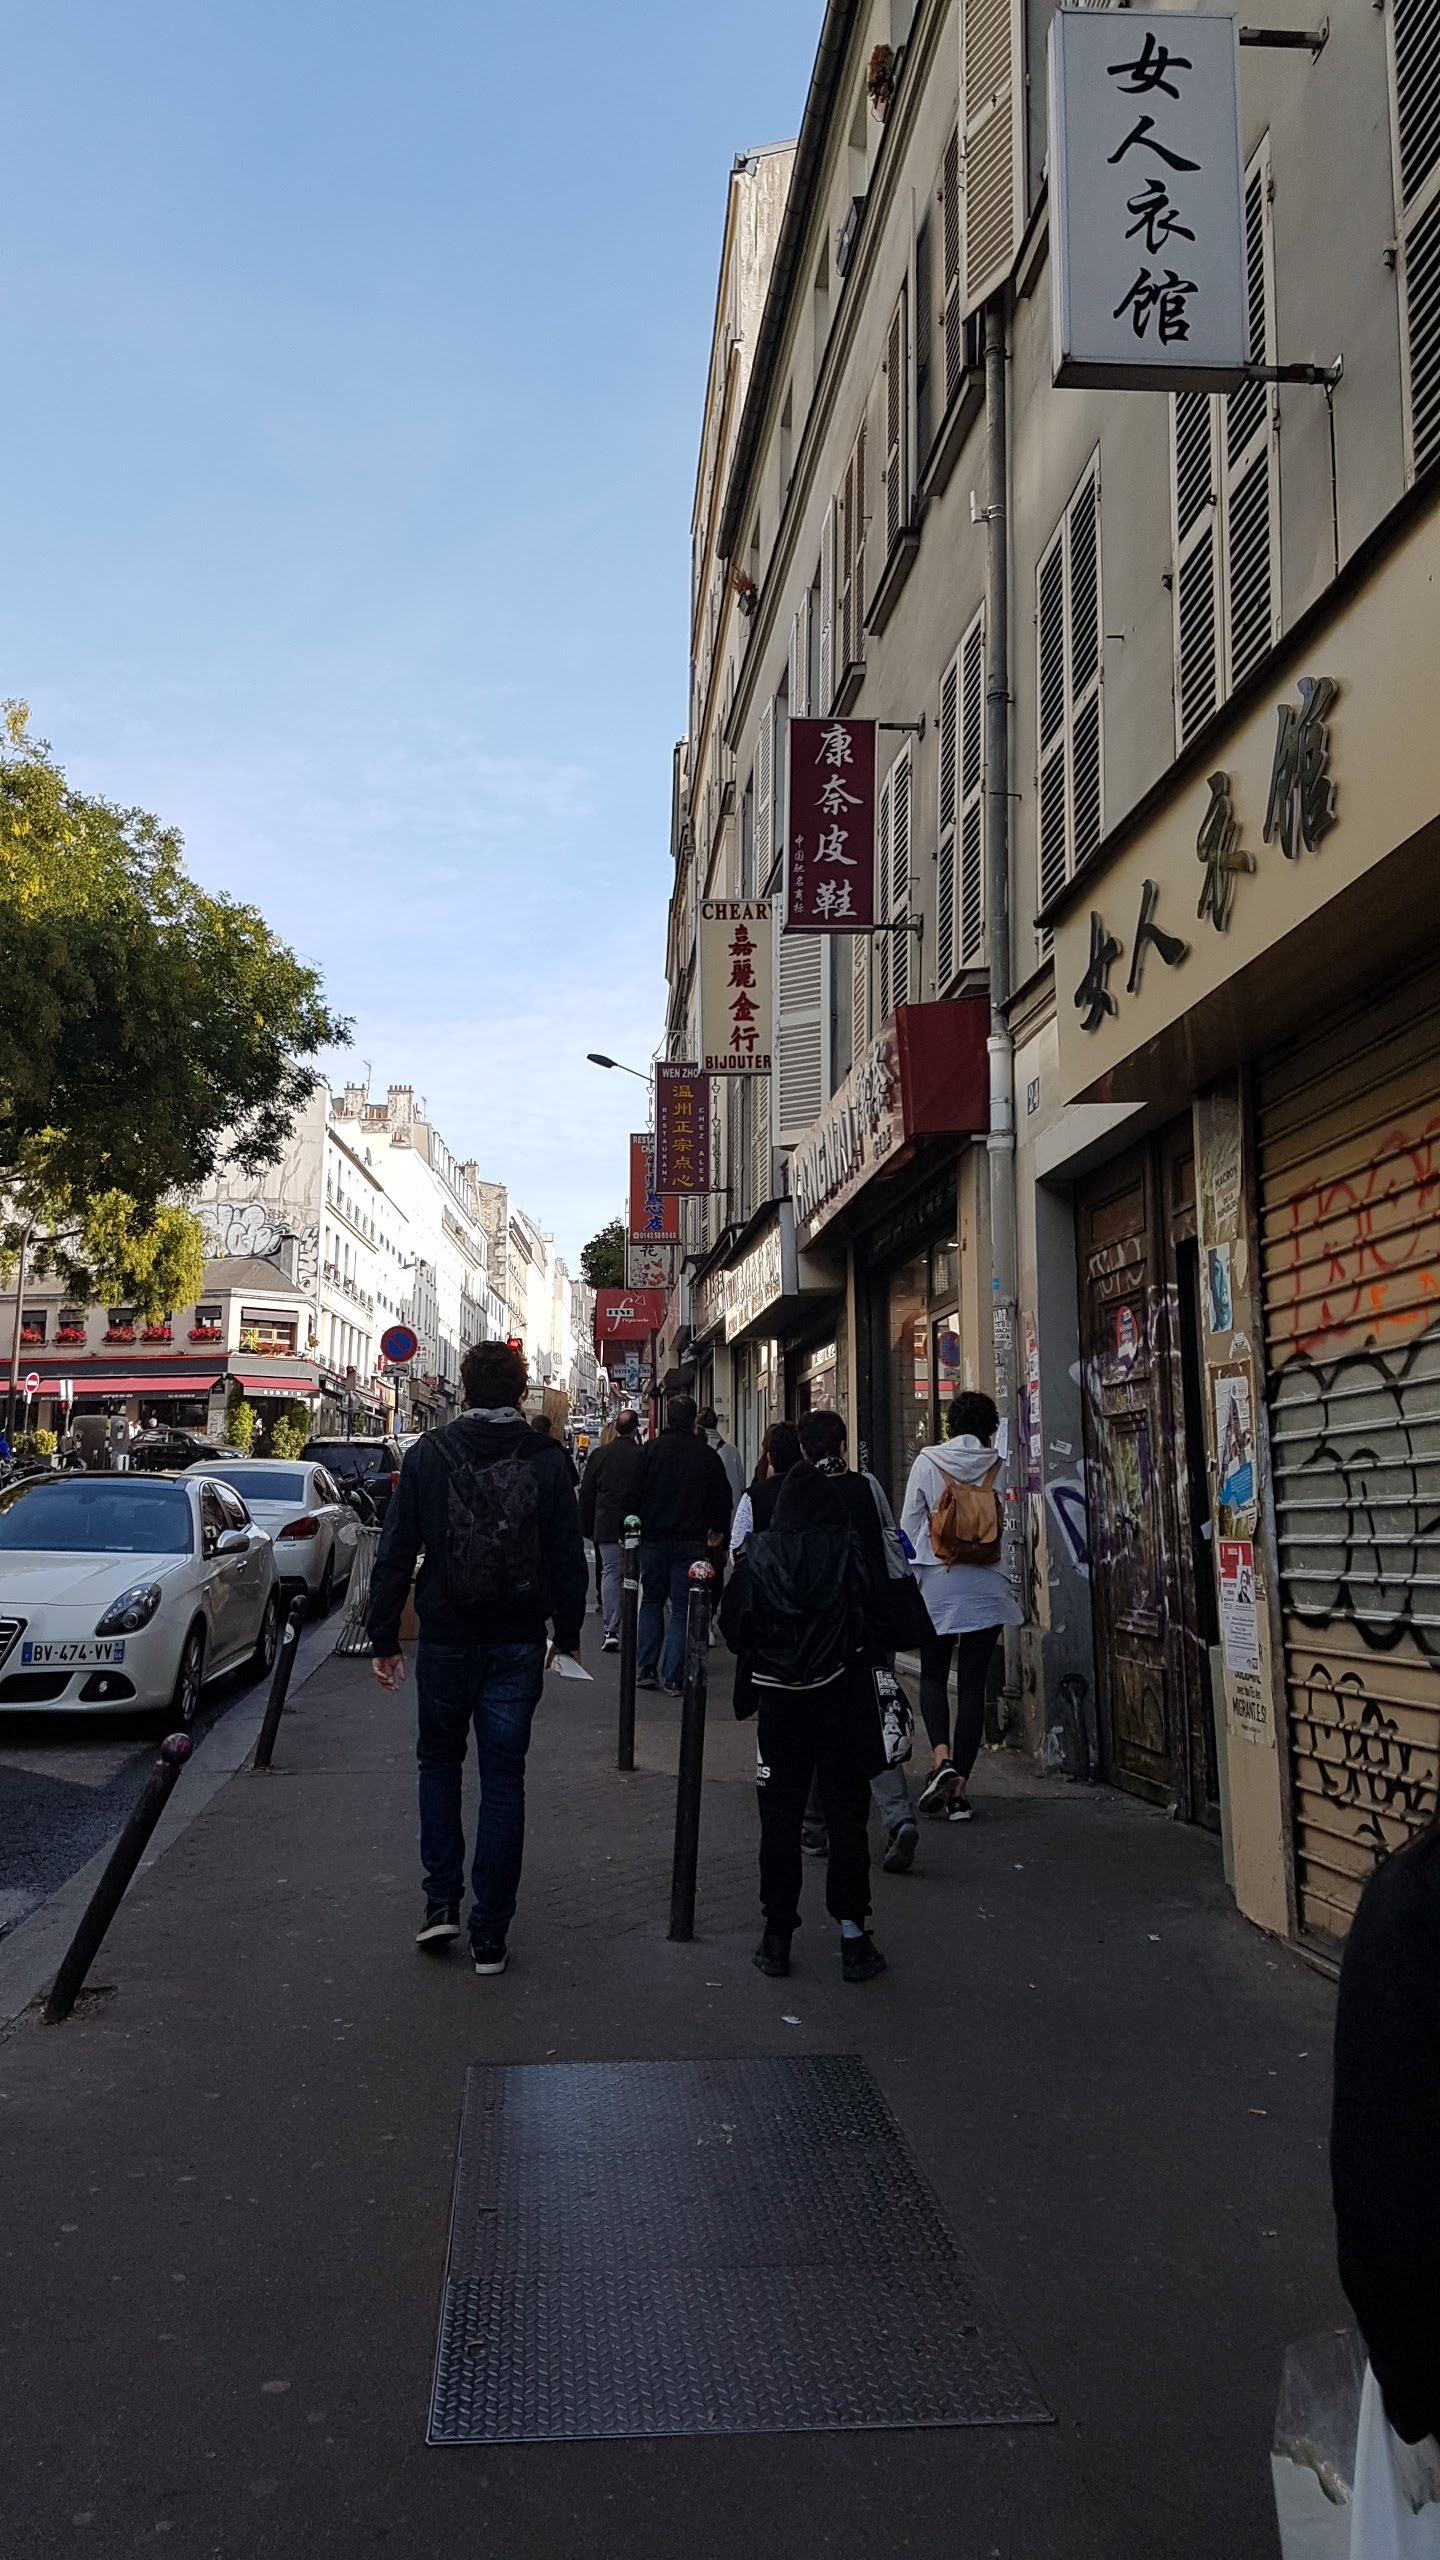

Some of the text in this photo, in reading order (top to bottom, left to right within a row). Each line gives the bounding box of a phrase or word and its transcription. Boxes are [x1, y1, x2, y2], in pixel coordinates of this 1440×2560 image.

[1107, 32, 1201, 346] 女人衣馆
[812, 724, 863, 920] 康奈皮鞋
[727, 923, 761, 1053] 嘉麗金行
[662, 1068, 704, 1078] WEN ZHO
[1028, 1079, 1040, 1114] 24
[33, 1643, 112, 1661] BV-474-VV
